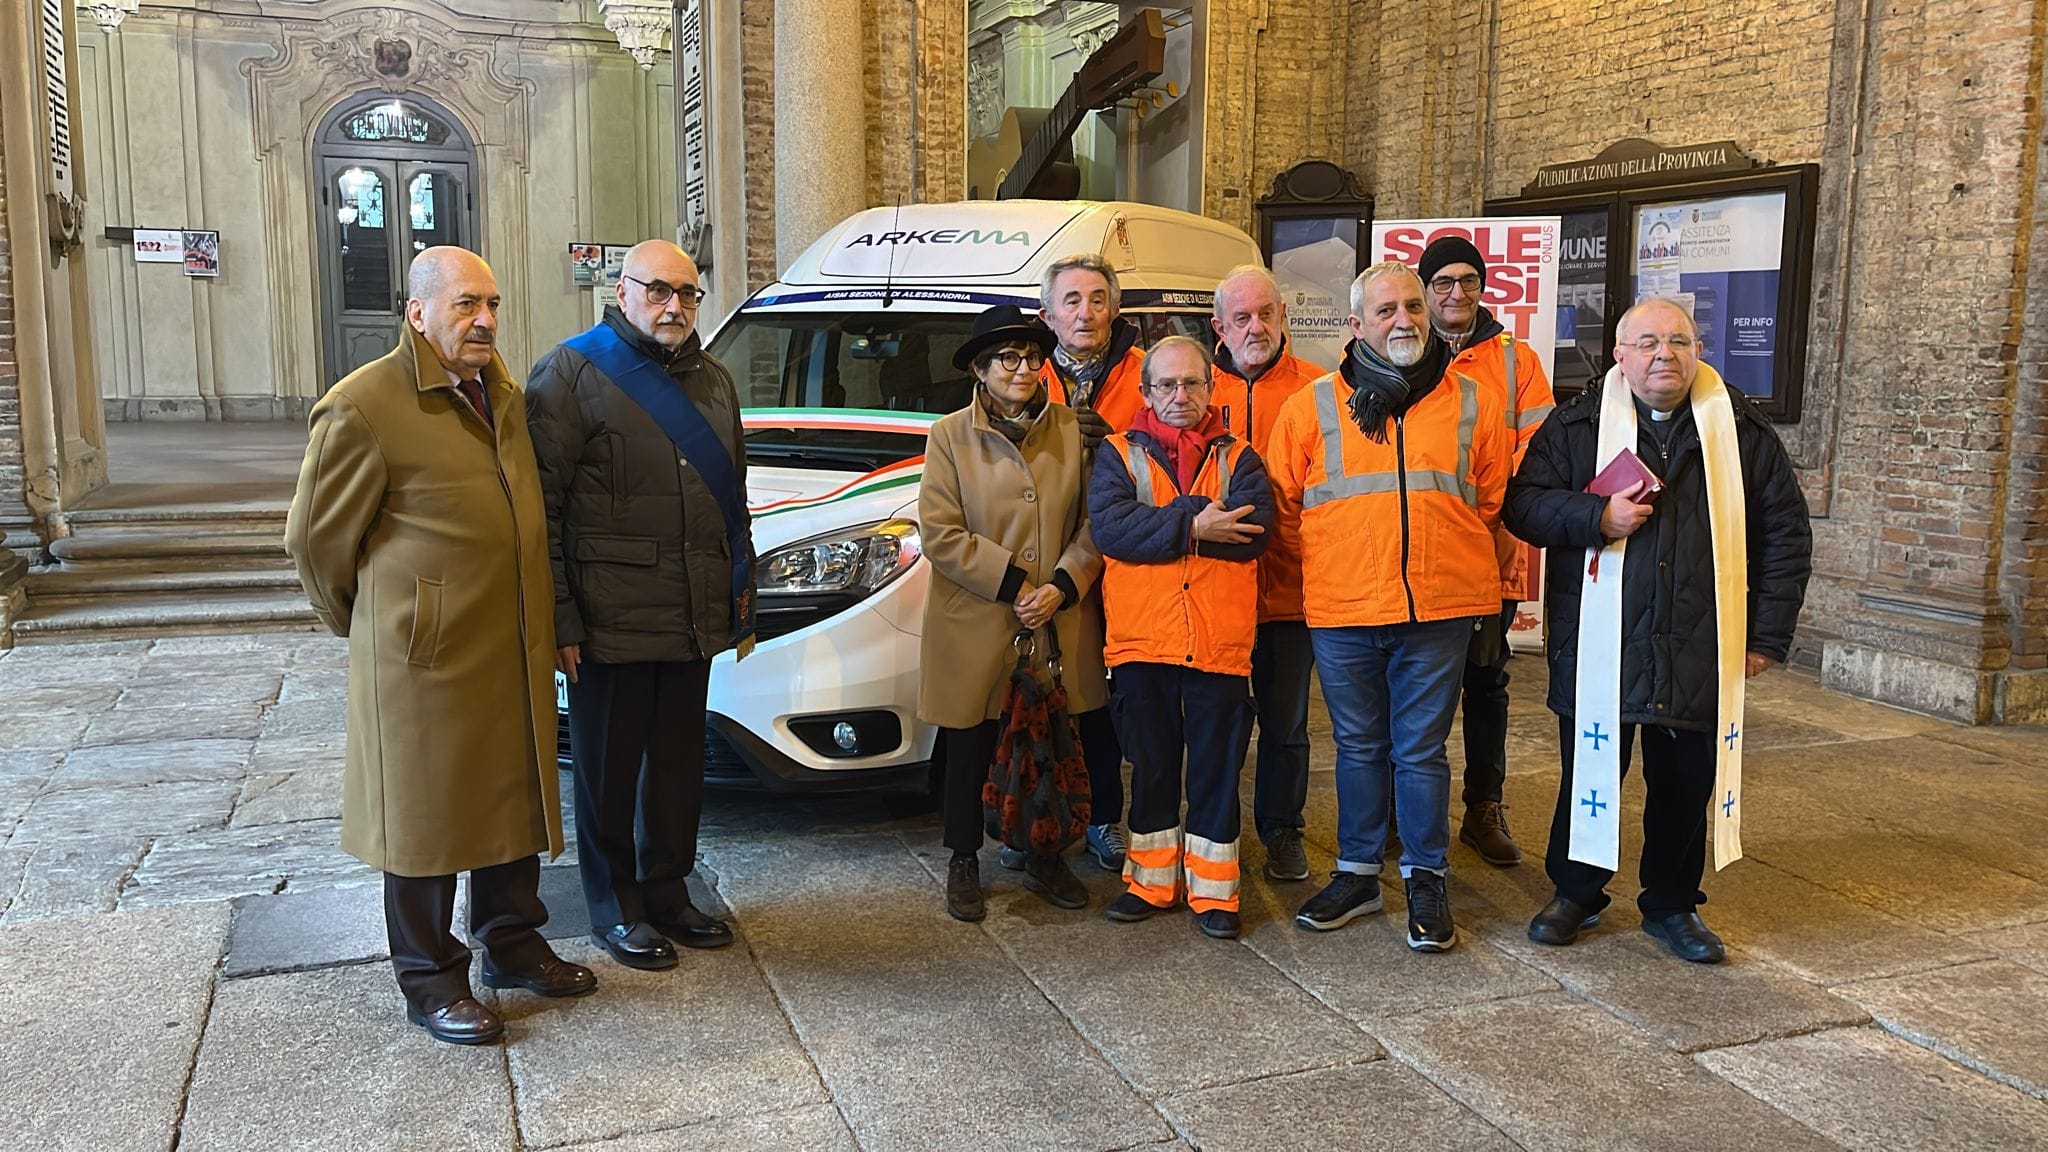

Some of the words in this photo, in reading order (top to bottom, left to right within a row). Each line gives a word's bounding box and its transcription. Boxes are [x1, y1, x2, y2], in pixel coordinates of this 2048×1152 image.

[1621, 158, 1655, 177] DELLA
[1657, 148, 1727, 171] PROVINCIA
[846, 229, 1030, 248] ARKEMA
[1542, 225, 1554, 264] ONLUS
[824, 291, 848, 300] AISM
[901, 291, 971, 301] ALESSANDRIA
[1290, 317, 1349, 327] PROVINCIA
[1733, 317, 1750, 327] PER
[1751, 317, 1774, 327] INFO
